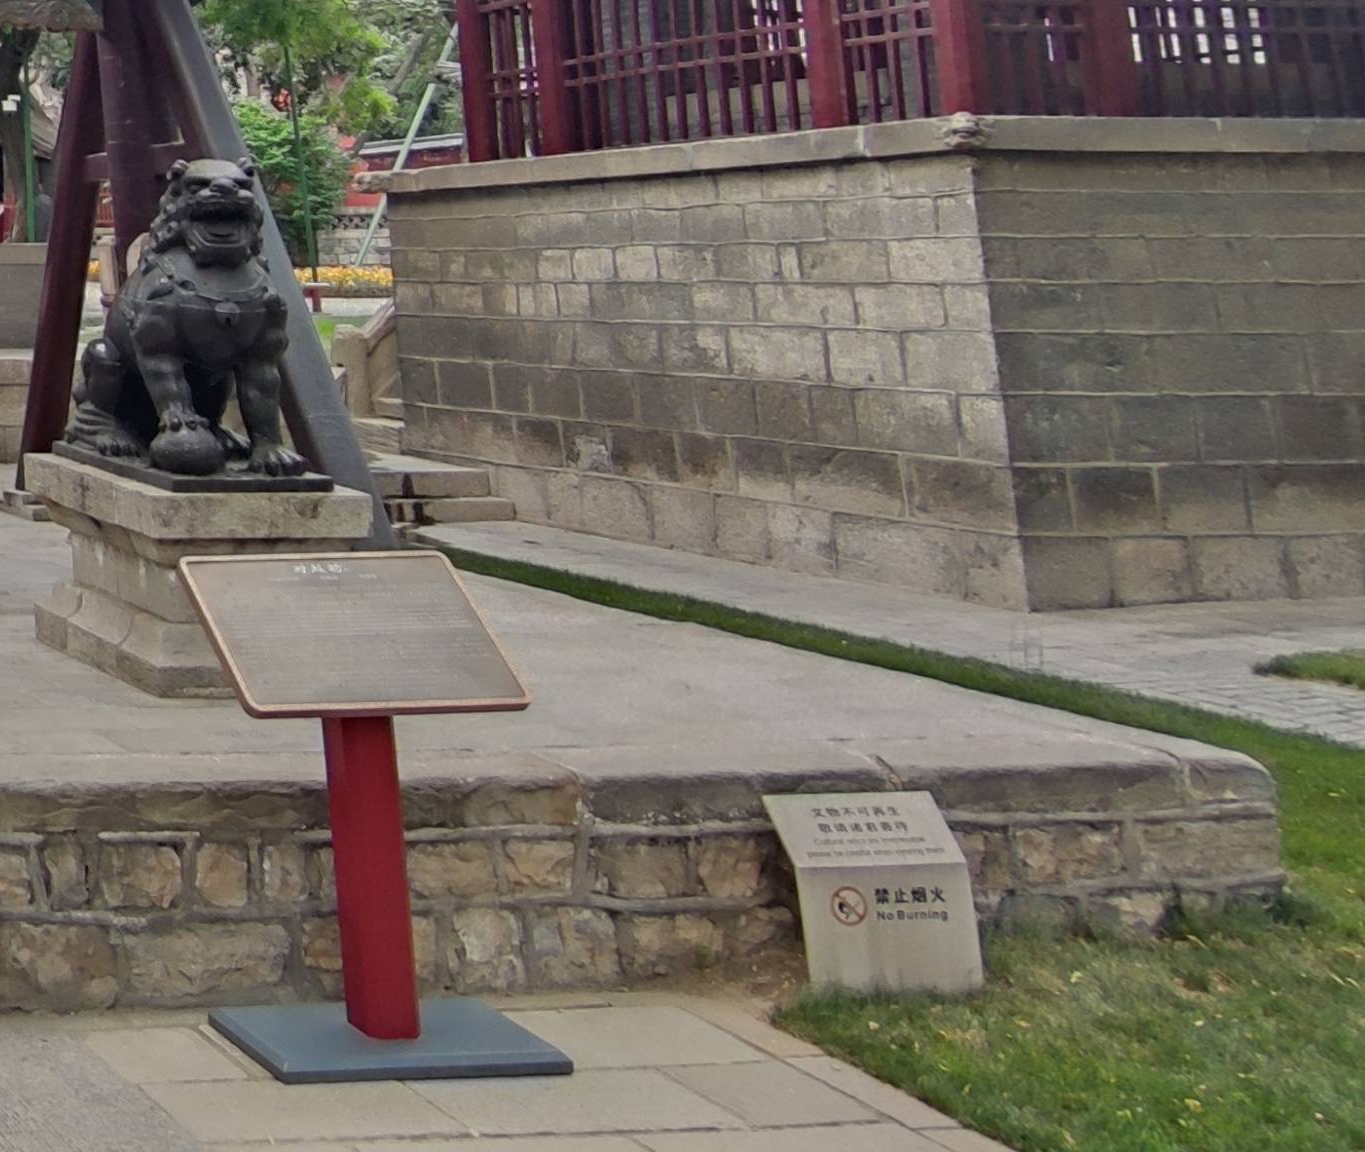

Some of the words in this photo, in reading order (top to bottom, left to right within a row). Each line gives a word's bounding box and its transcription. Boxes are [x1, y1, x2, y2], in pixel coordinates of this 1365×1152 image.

[810, 805, 901, 818] 文物不可再生
[874, 885, 946, 905] 禁止烟火
[876, 910, 895, 921] No
[896, 908, 949, 922] Burning
